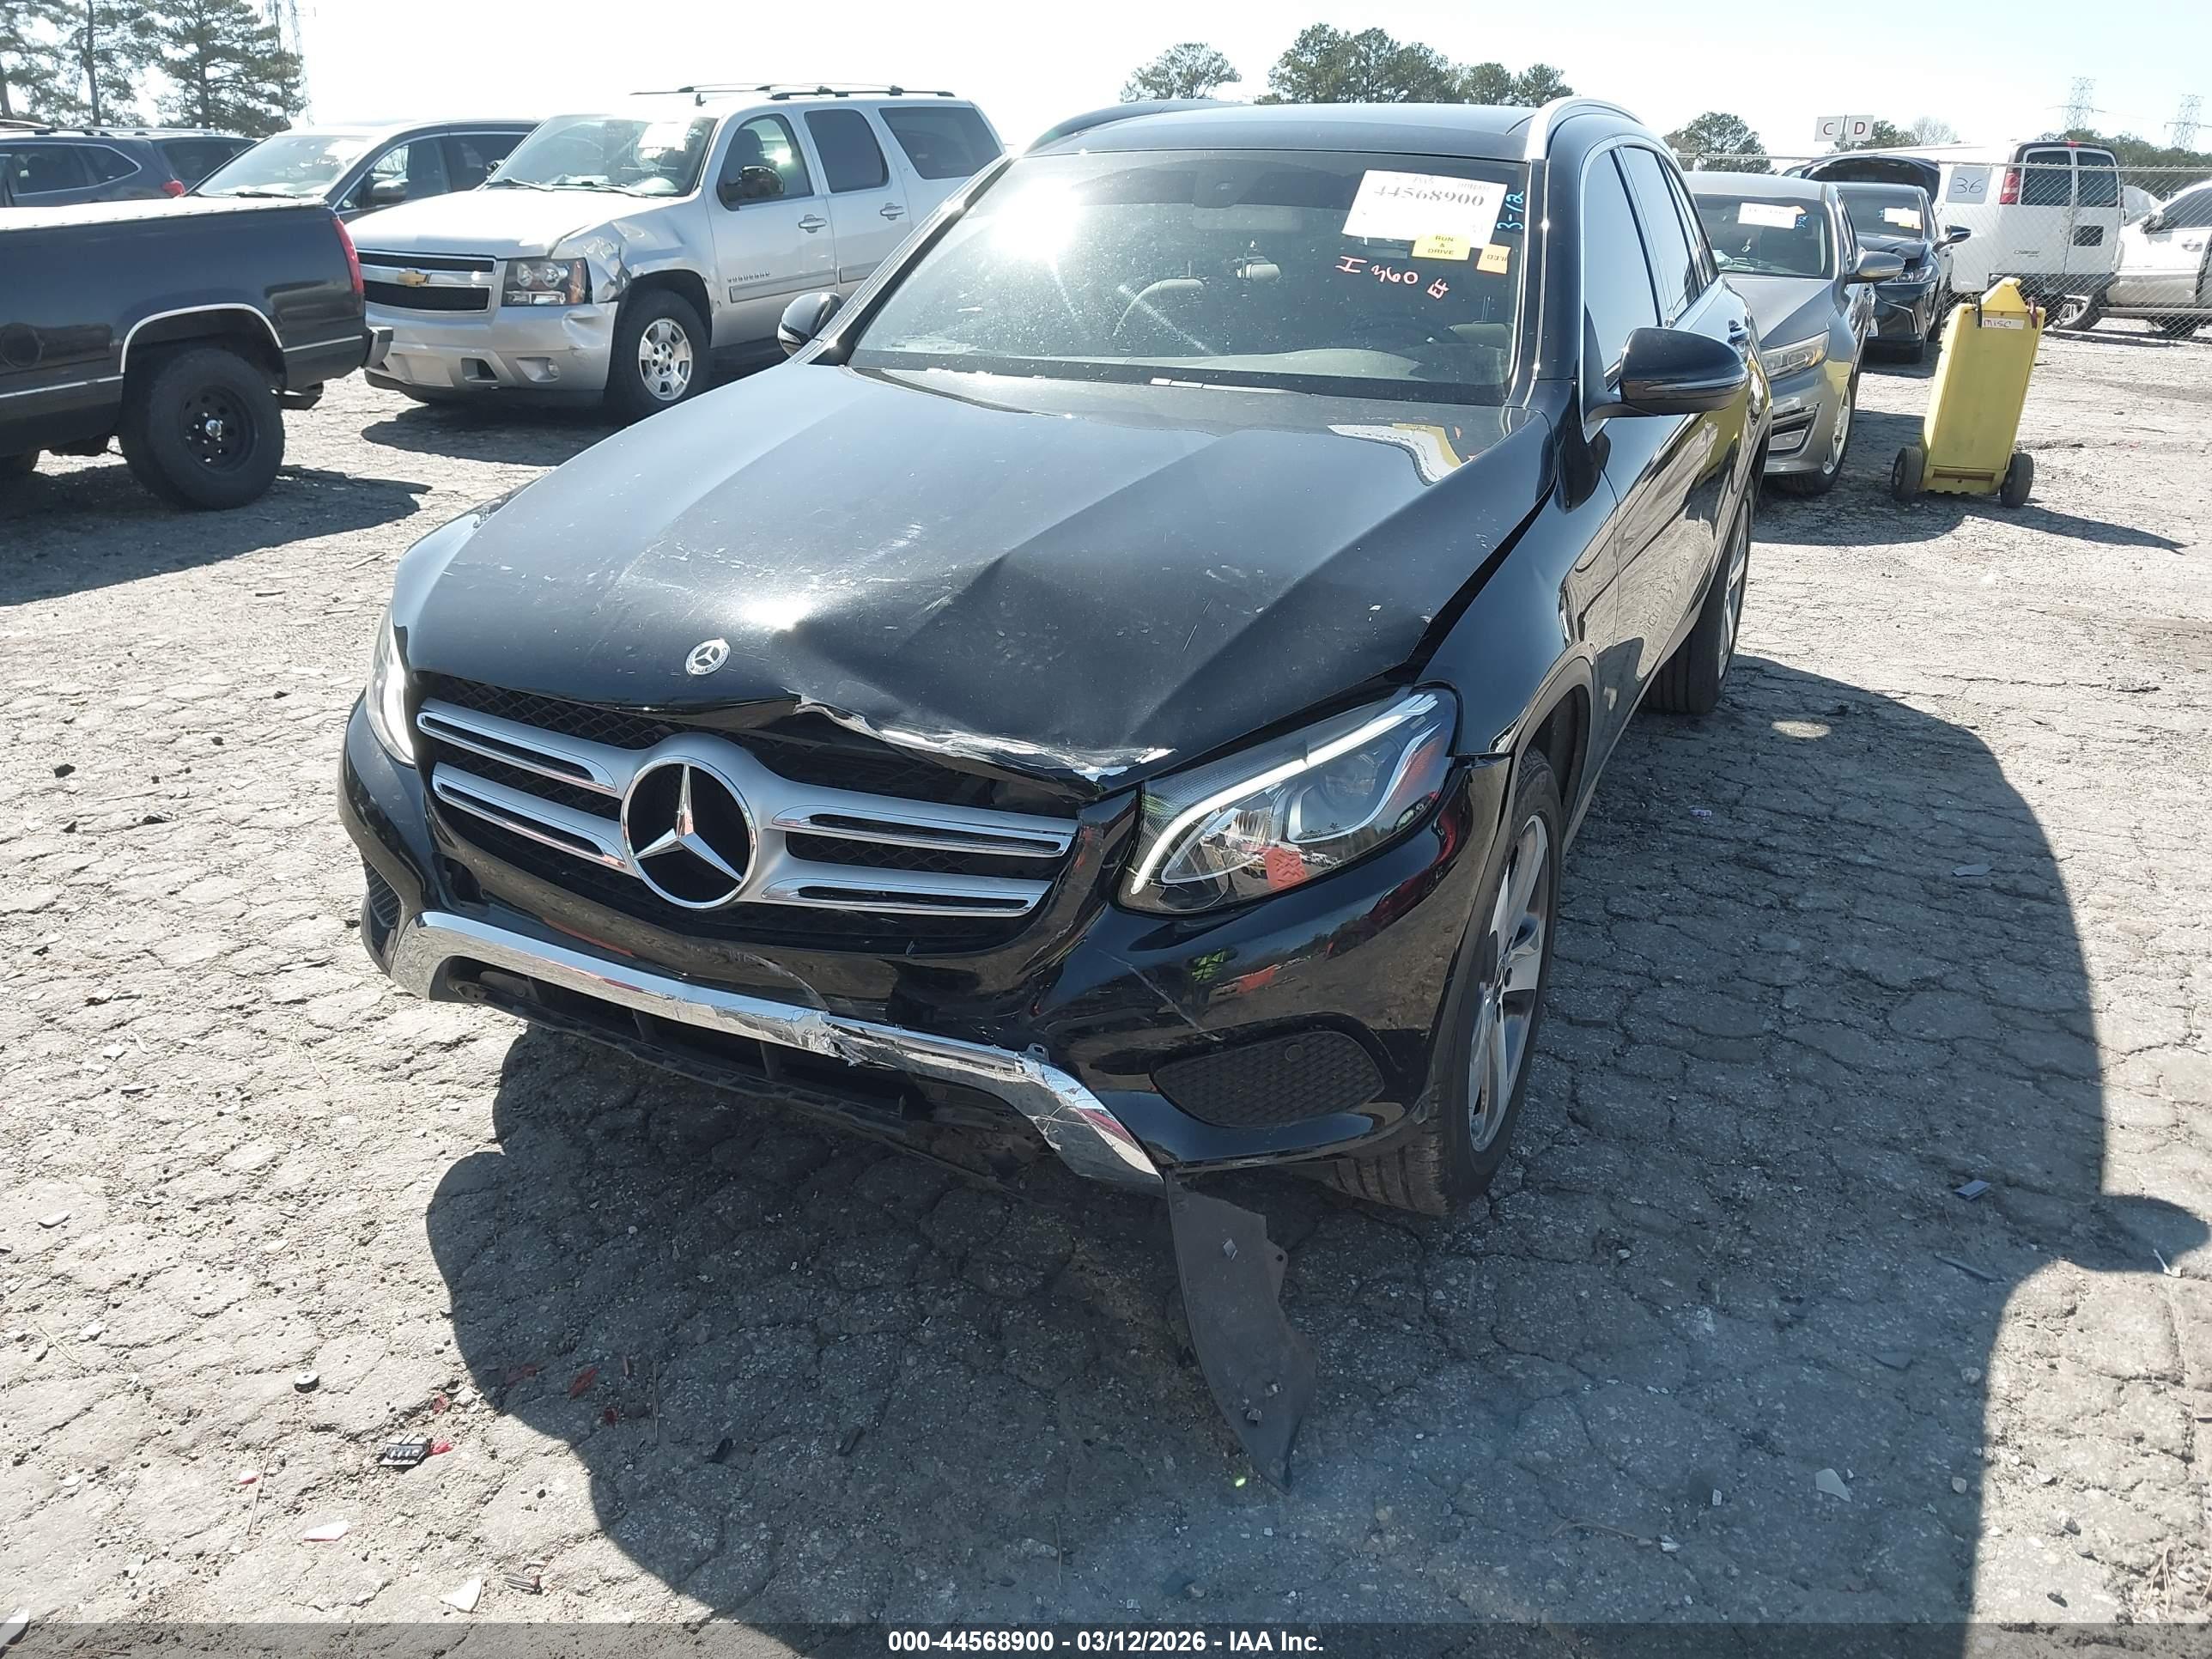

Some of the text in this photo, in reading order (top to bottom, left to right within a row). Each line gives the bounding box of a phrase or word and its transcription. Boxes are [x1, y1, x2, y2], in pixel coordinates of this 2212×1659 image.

[1822, 122, 1835, 136] C
[1854, 121, 1866, 135] D
[1953, 176, 1984, 195] 36
[1373, 185, 1485, 207] 44568900
